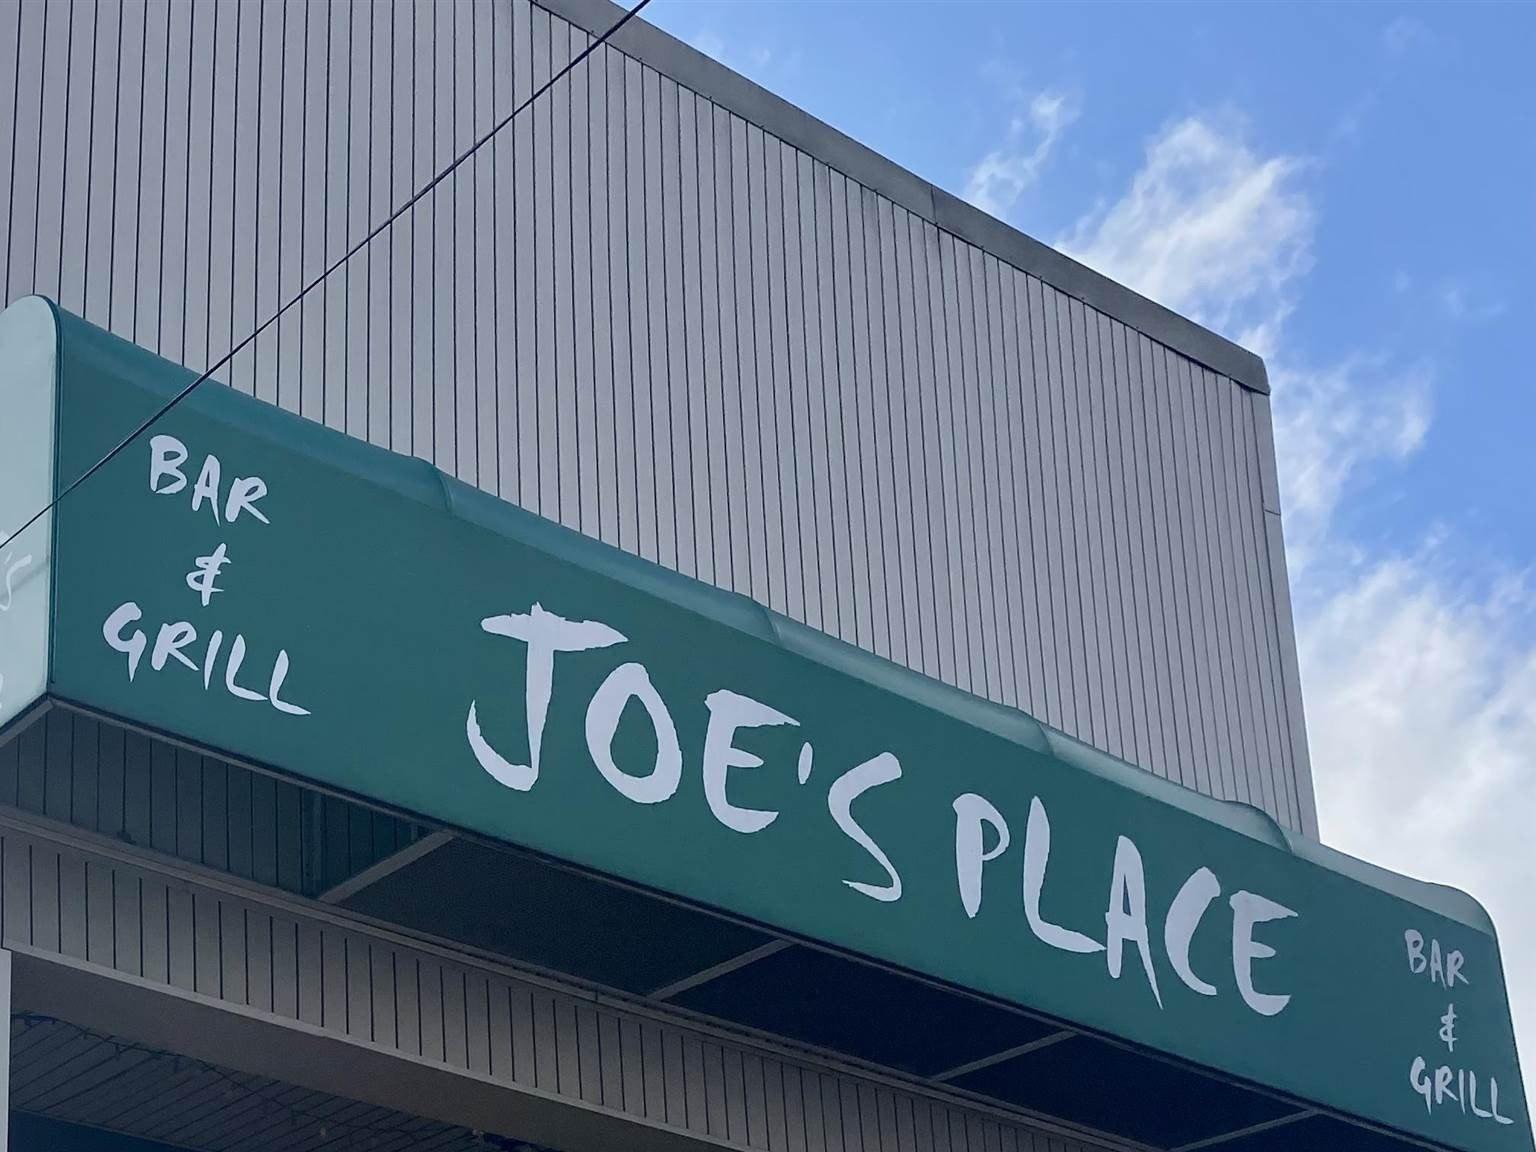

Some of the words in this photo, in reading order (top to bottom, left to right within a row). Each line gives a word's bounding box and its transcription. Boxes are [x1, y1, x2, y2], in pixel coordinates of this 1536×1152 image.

[149, 434, 270, 527] BAR
[185, 542, 232, 607] &
[102, 601, 312, 715] GRILL
[466, 601, 903, 902] JOE'S
[952, 792, 1299, 1016] PLACE
[1404, 928, 1470, 990] BAR
[1439, 1003, 1458, 1052] &
[1410, 1056, 1514, 1124] GRILL
